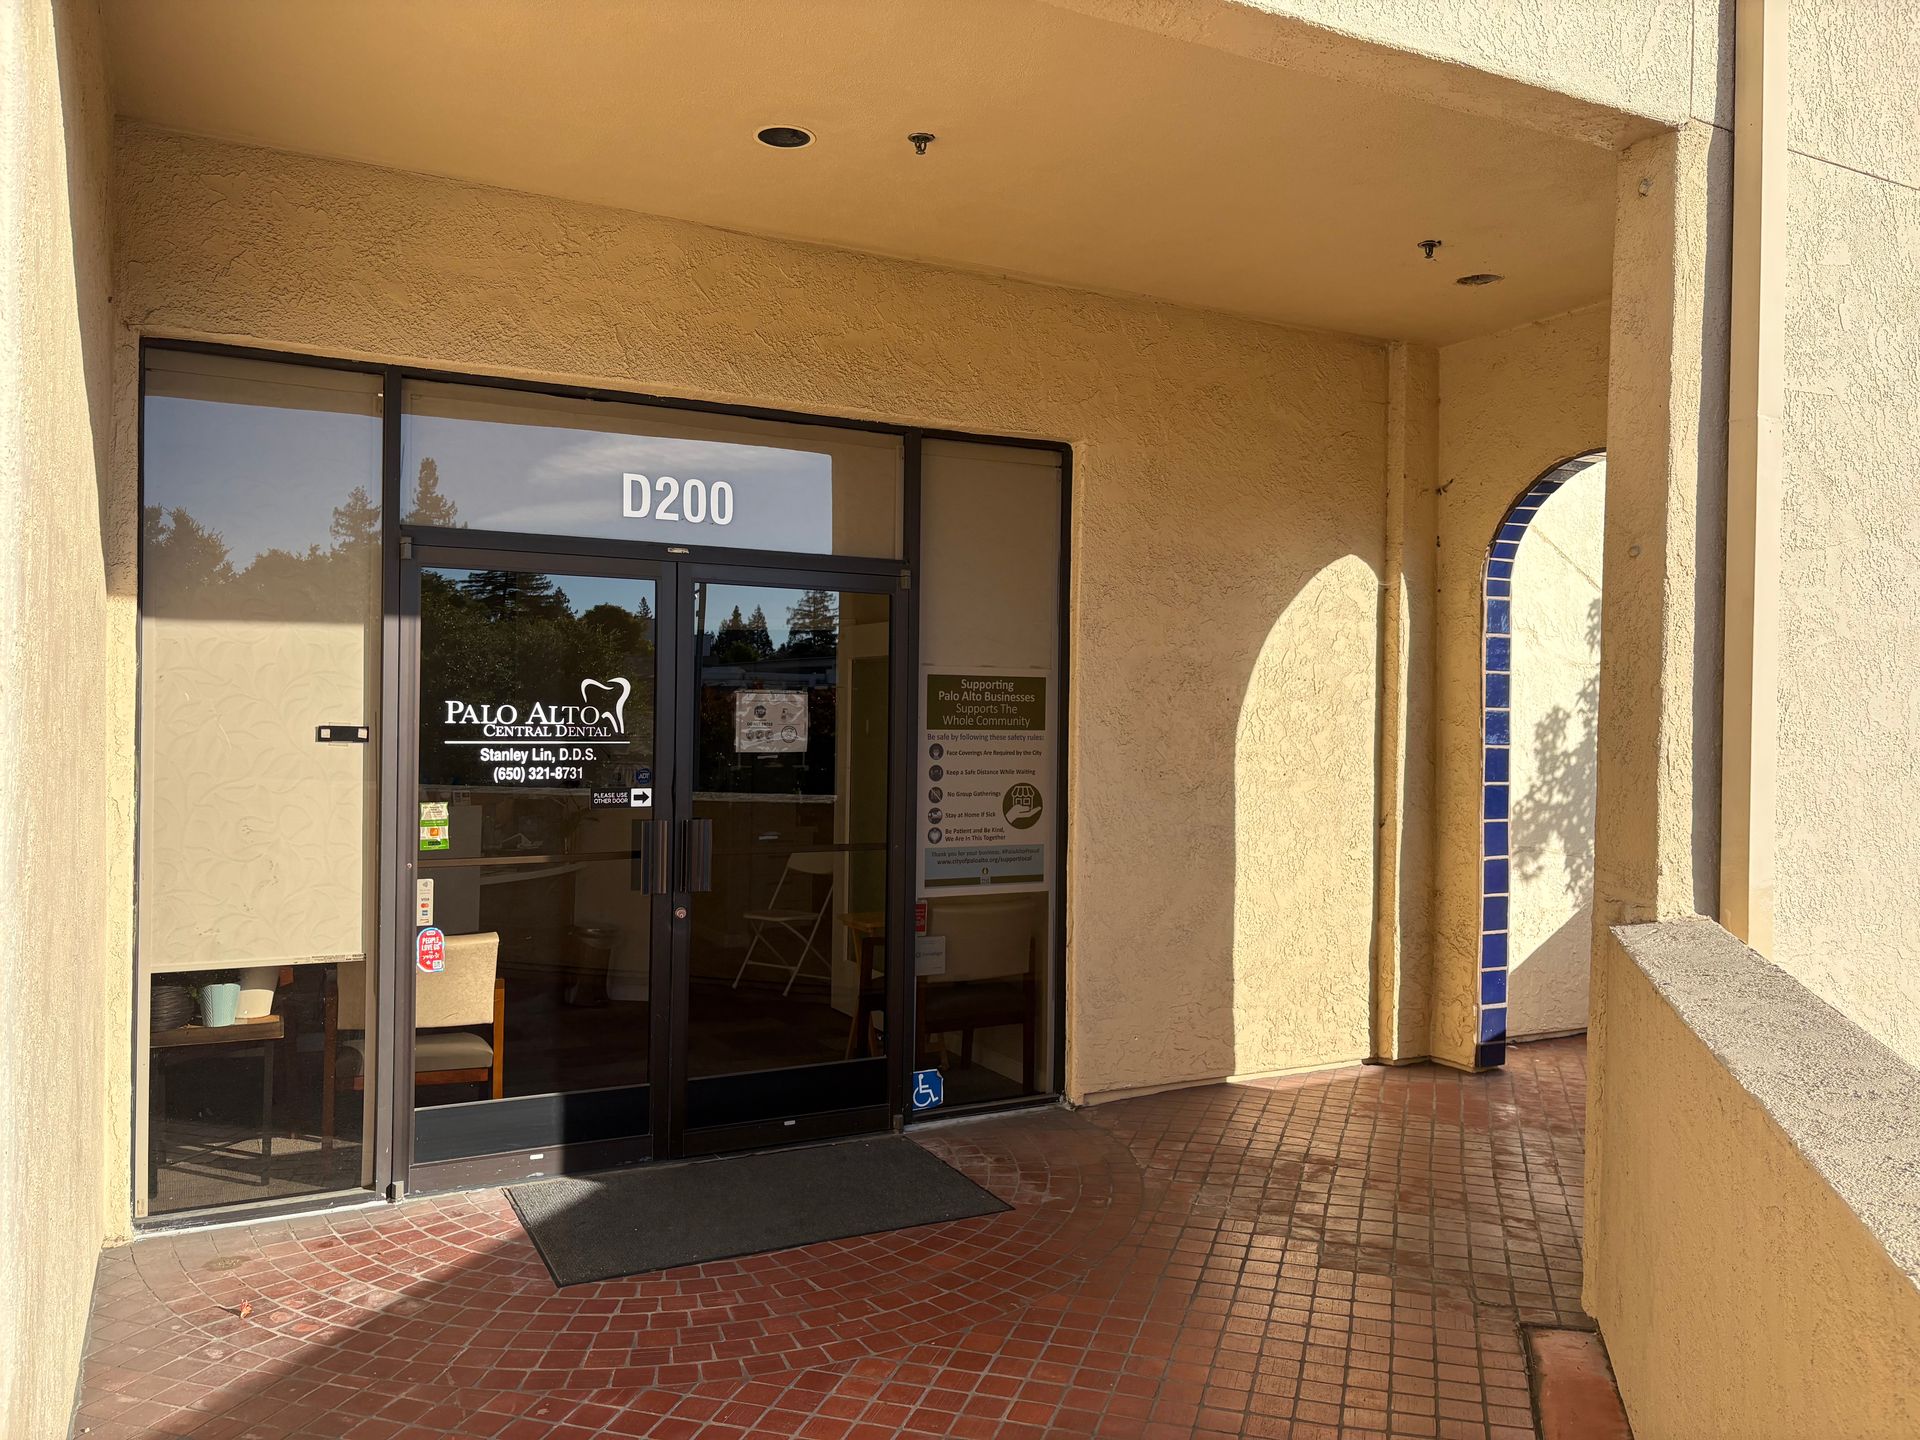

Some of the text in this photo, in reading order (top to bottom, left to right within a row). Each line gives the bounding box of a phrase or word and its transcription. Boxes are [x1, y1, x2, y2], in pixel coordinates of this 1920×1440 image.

[623, 472, 734, 525] D200
[961, 679, 1014, 692] Supporting
[938, 690, 1035, 702] Palo Alto Businesses
[444, 700, 600, 725] PALO ALTO
[956, 703, 1018, 715] Supports The
[943, 715, 1031, 728] Whole Community
[483, 724, 611, 737] CENTRAL DENTAL
[951, 733, 959, 741] by
[480, 748, 597, 764] Stanley Lin, D.D.S.
[493, 766, 583, 783] (650) 321-8731
[422, 937, 440, 945] PEOPLE
